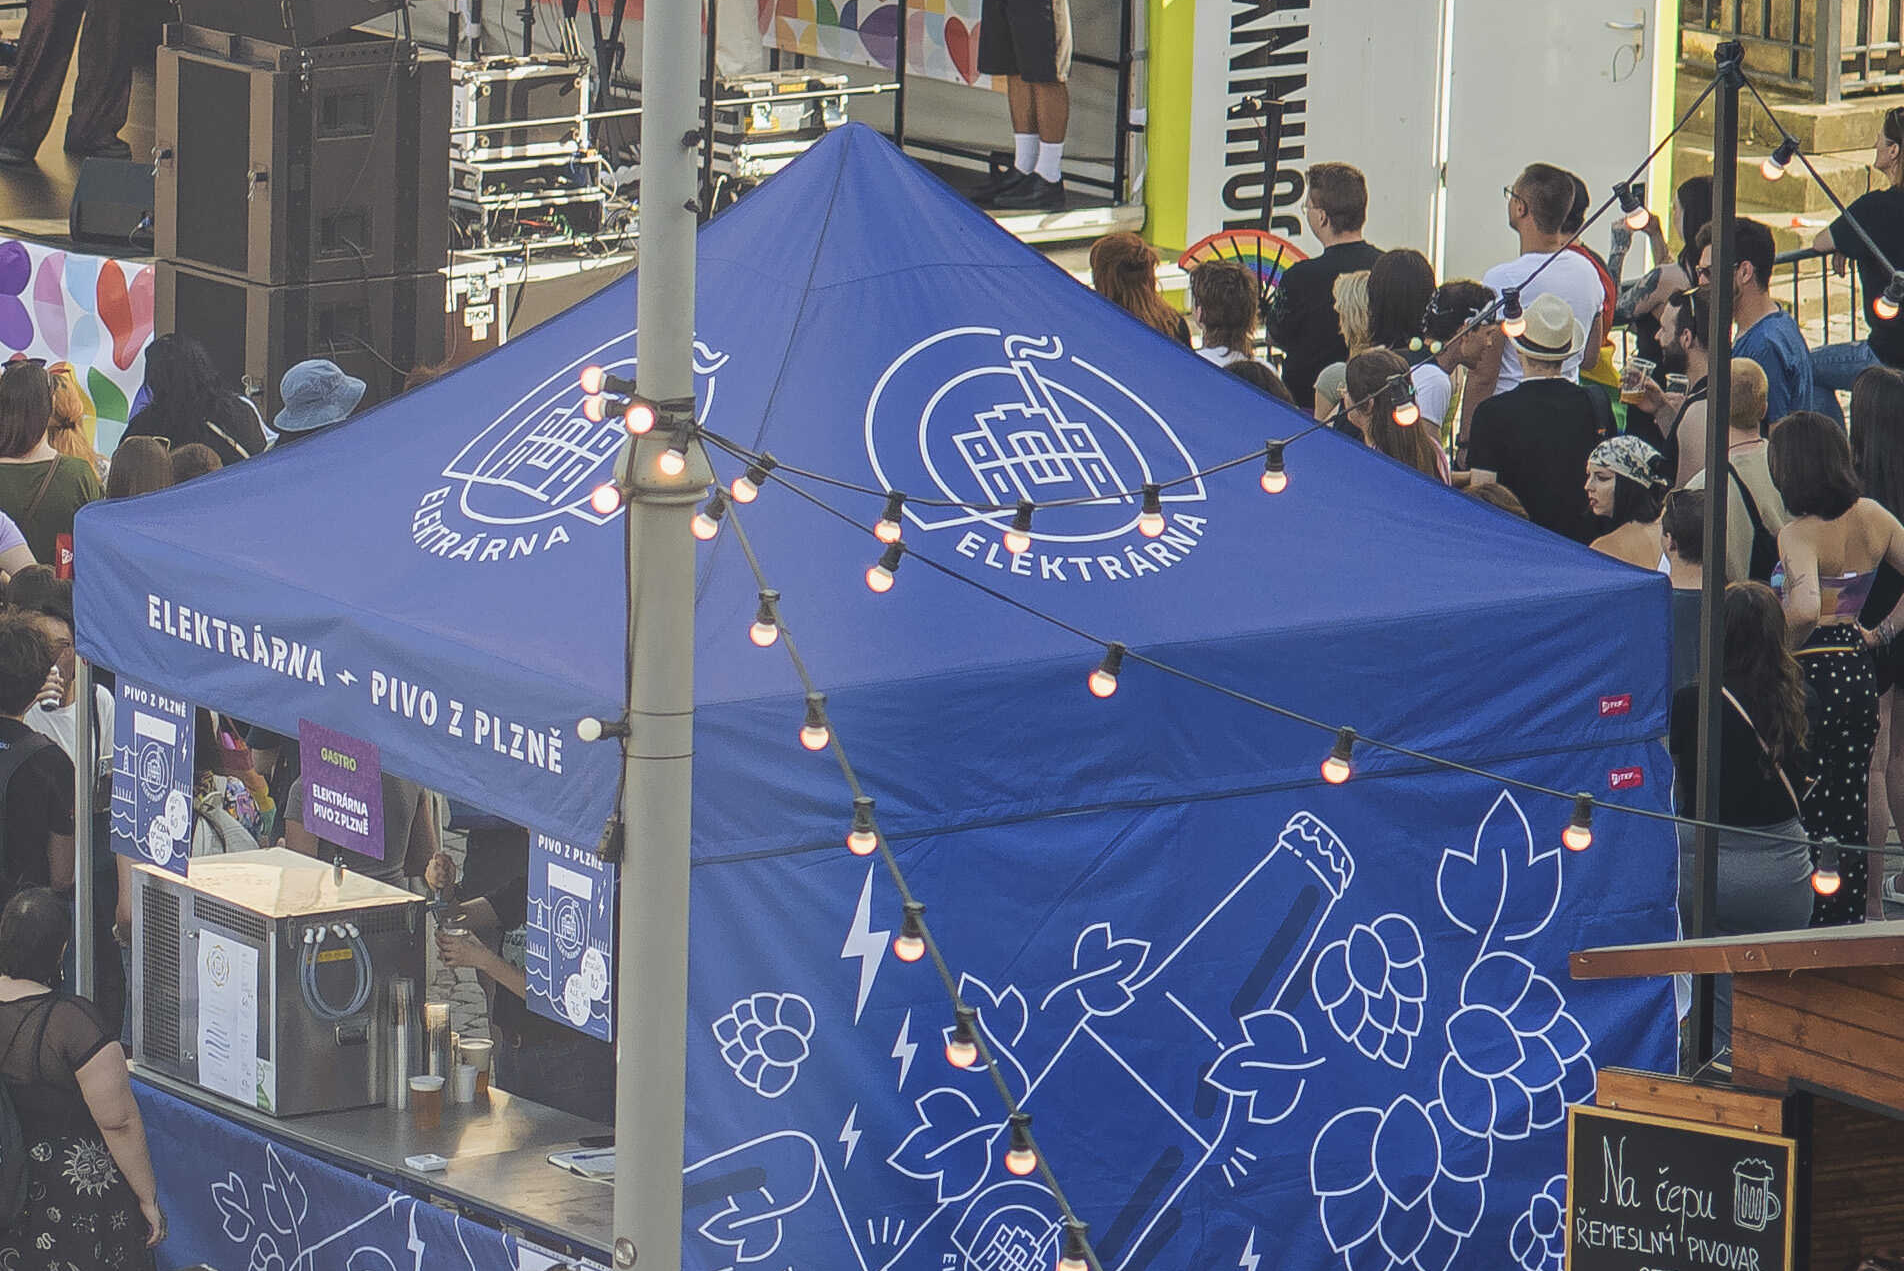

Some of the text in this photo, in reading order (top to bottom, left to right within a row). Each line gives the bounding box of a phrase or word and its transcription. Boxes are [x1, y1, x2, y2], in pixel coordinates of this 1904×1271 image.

[412, 485, 572, 563] ELEKTRÁRNA
[955, 512, 1209, 583] ELEKTRÁRNA
[123, 684, 187, 720] PIVO Z PLZNĚ
[147, 593, 564, 776] ELEKTRÁRNA PIVO Z PLZNĚ
[320, 747, 357, 772] GASTRO
[312, 783, 369, 818] ELEKTRÁRNA
[313, 802, 369, 837] PIVO Z PLZNĚ
[538, 833, 562, 857] PIVO
[564, 843, 572, 859] Z
[1600, 1135, 1717, 1243] Na čepu
[1576, 1206, 1676, 1256] ŘEMESLNÝ
